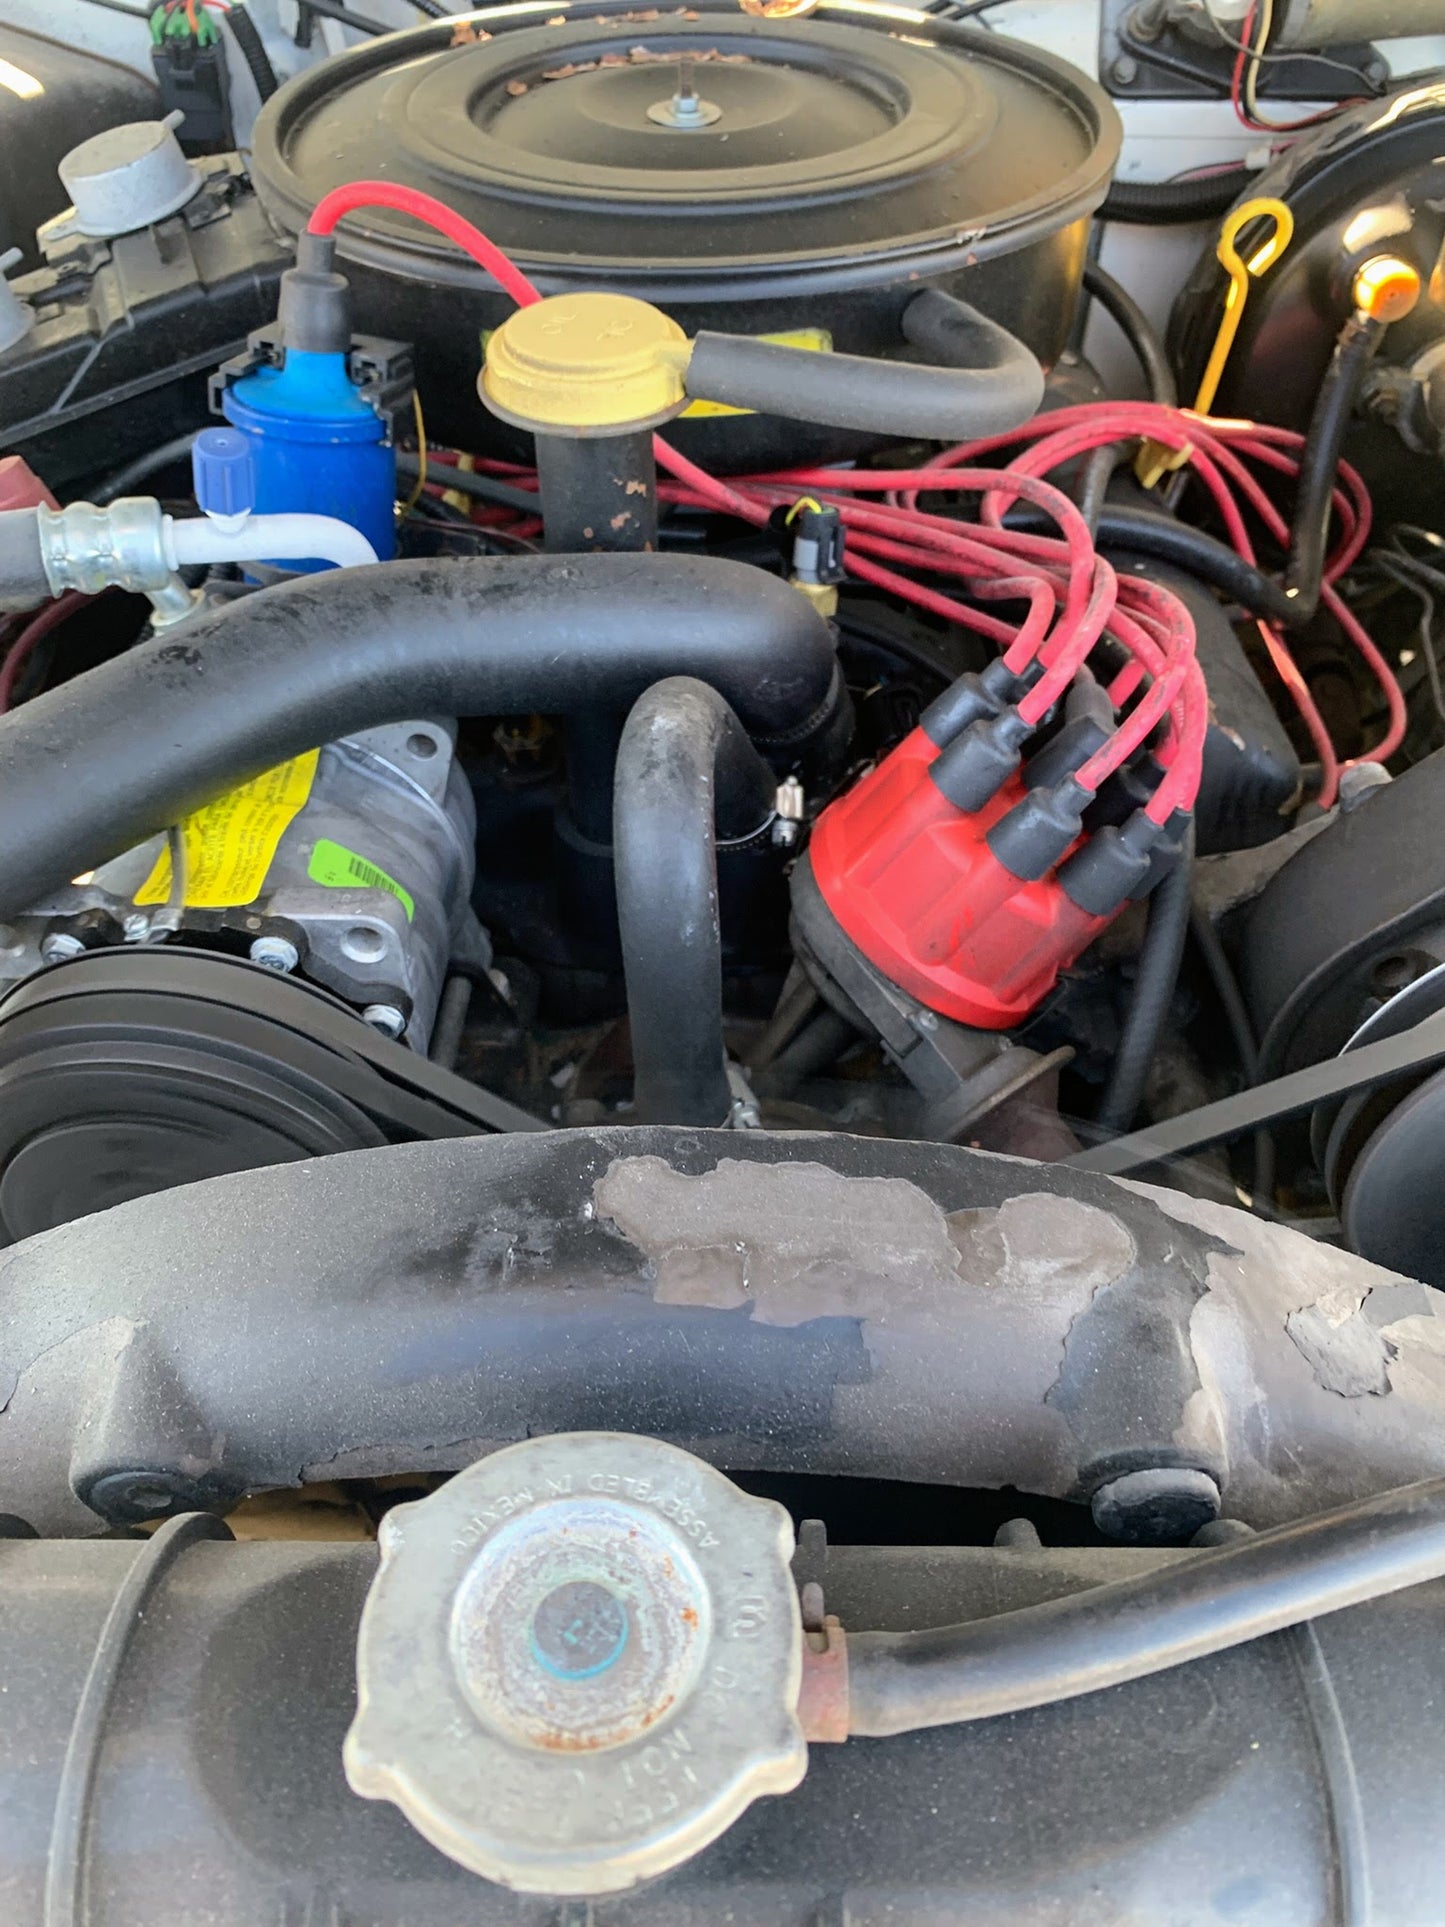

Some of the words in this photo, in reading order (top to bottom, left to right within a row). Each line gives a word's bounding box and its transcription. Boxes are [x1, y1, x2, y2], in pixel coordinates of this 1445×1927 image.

[449, 1484, 536, 1557] MEXICO
[545, 1474, 574, 1496] IN
[586, 1472, 721, 1551] ASSEMBLED
